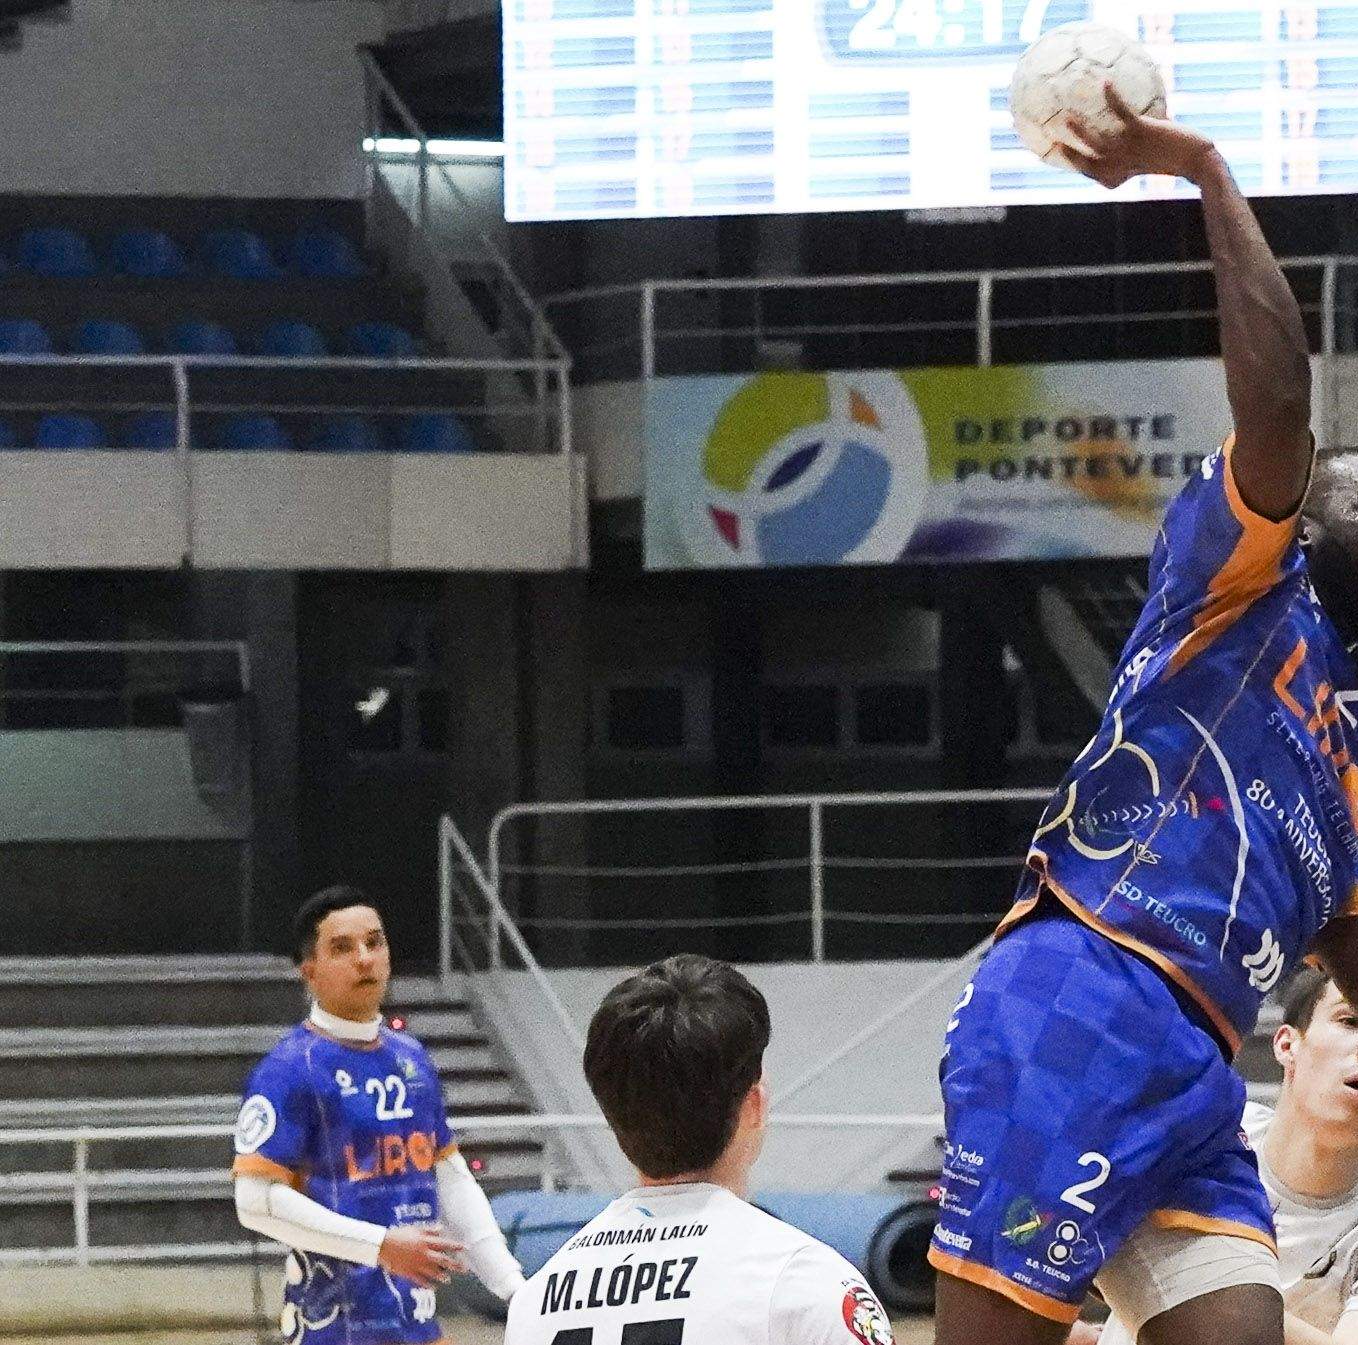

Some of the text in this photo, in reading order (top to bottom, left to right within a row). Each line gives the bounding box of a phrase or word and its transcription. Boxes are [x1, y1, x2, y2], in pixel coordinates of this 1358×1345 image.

[955, 414, 1176, 442] DEPORTE
[955, 451, 1203, 482] PONTEVED
[1115, 880, 1207, 946] SD TEUCRO
[365, 1074, 414, 1121] 22
[1060, 1151, 1112, 1214] 2
[568, 1221, 709, 1250] BALONMÁN LALÍN
[540, 1253, 699, 1316] M.LÓPEZ
